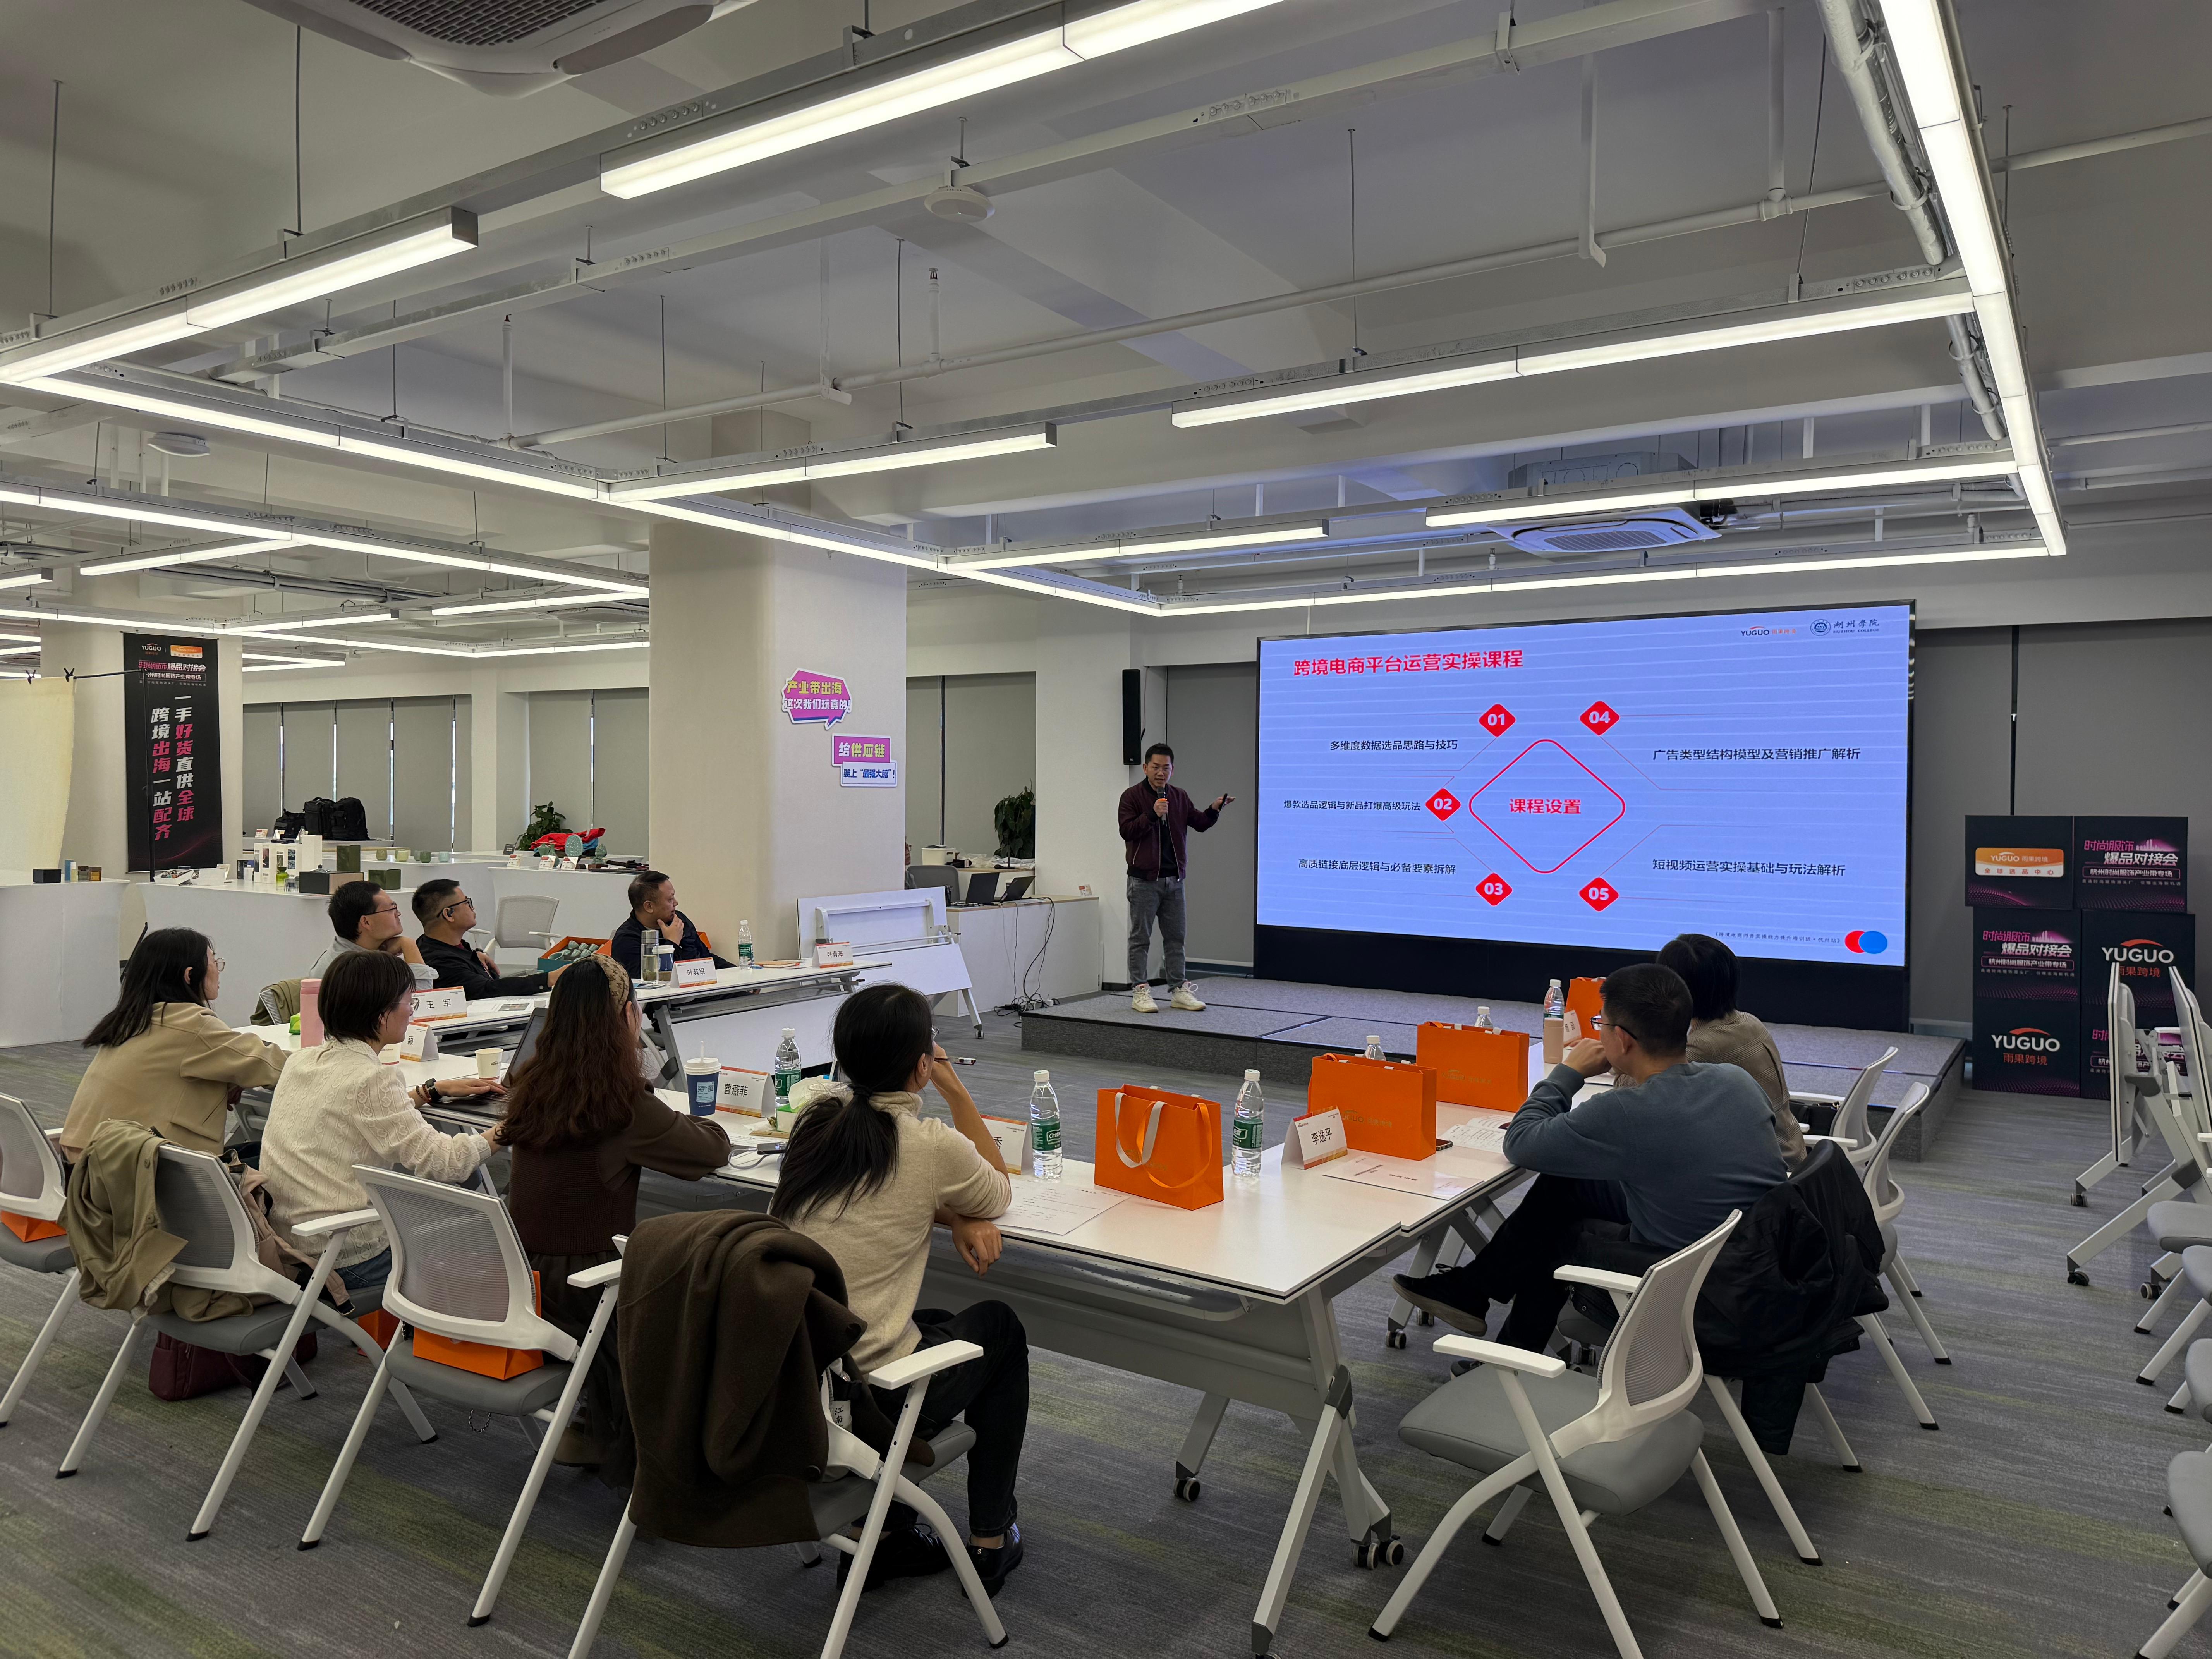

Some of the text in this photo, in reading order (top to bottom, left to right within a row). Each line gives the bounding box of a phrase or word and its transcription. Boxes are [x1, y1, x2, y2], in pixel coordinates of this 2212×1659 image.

[1294, 649, 1523, 676] 跨境电商平台运营实操课程
[787, 680, 842, 695] 产业带出海
[1488, 713, 1505, 726] 01
[1589, 711, 1611, 723] 04
[839, 742, 885, 758] 给供应链
[1330, 739, 1458, 751] 多维度数据选品思路与技巧
[174, 695, 194, 822] 一手好货直供全球
[1652, 748, 1861, 760] 广告类型结构模型及营销推广解析
[150, 707, 172, 841] 跨境出海一站配齐
[1284, 800, 1421, 811] 爆款选品逻辑与新品打爆高级玩法
[1434, 798, 1452, 810] 02
[1509, 799, 1582, 814] 课程设置
[2084, 840, 2134, 851] 时尚服饰
[2104, 852, 2178, 866] 爆品对接会
[1298, 859, 1456, 875] 高质链接底层逻辑与必备要素拆解
[1652, 859, 1846, 876] 短视频运营实操基础与玩法解析
[1484, 883, 1503, 895] 03
[1588, 887, 1609, 900] 05
[1982, 930, 2031, 942] 时尚服饰
[2001, 942, 2072, 958] 爆品对接会
[2101, 947, 2174, 963] YUGUO
[1991, 1034, 2060, 1052] YUGUO
[2003, 1053, 2047, 1065] 雨果跨境
[724, 1083, 748, 1097] 曹燕菲
[1311, 1127, 1332, 1145] 李逸平
